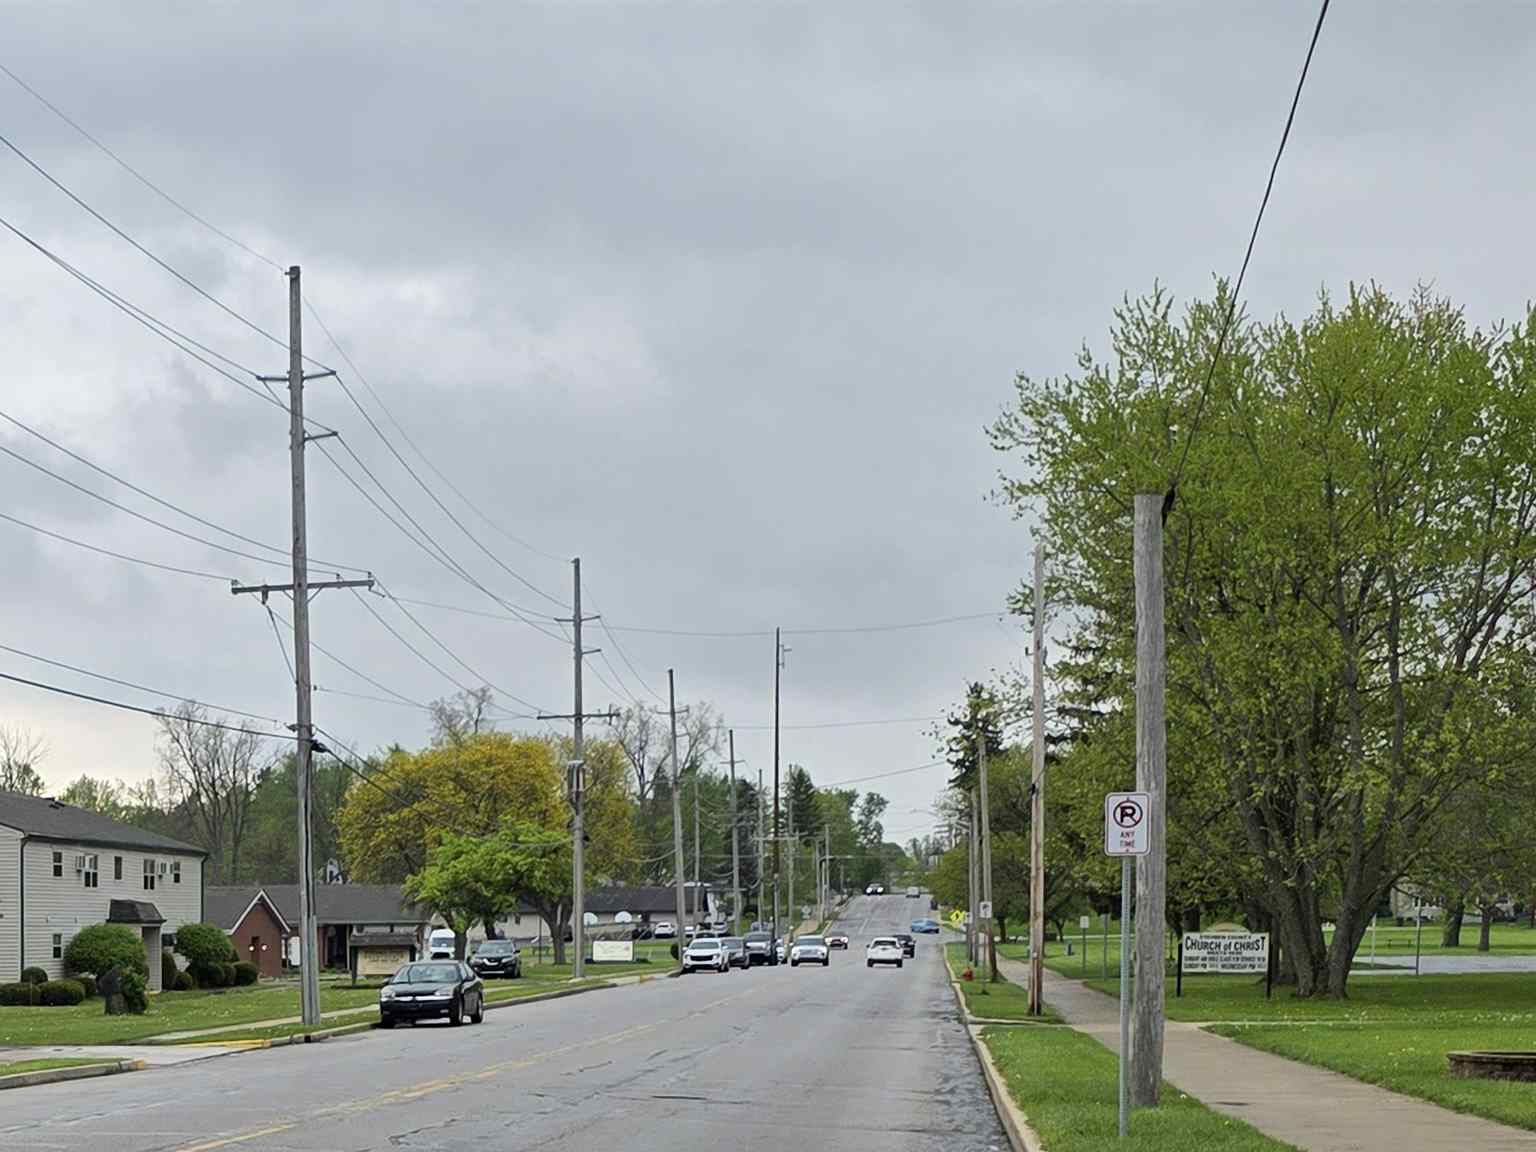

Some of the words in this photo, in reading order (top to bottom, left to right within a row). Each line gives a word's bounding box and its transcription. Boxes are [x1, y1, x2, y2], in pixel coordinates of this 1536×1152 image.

[1185, 936, 1222, 951] CHURCH
[1223, 941, 1232, 951] of
[1234, 936, 1265, 951] CHRIST
